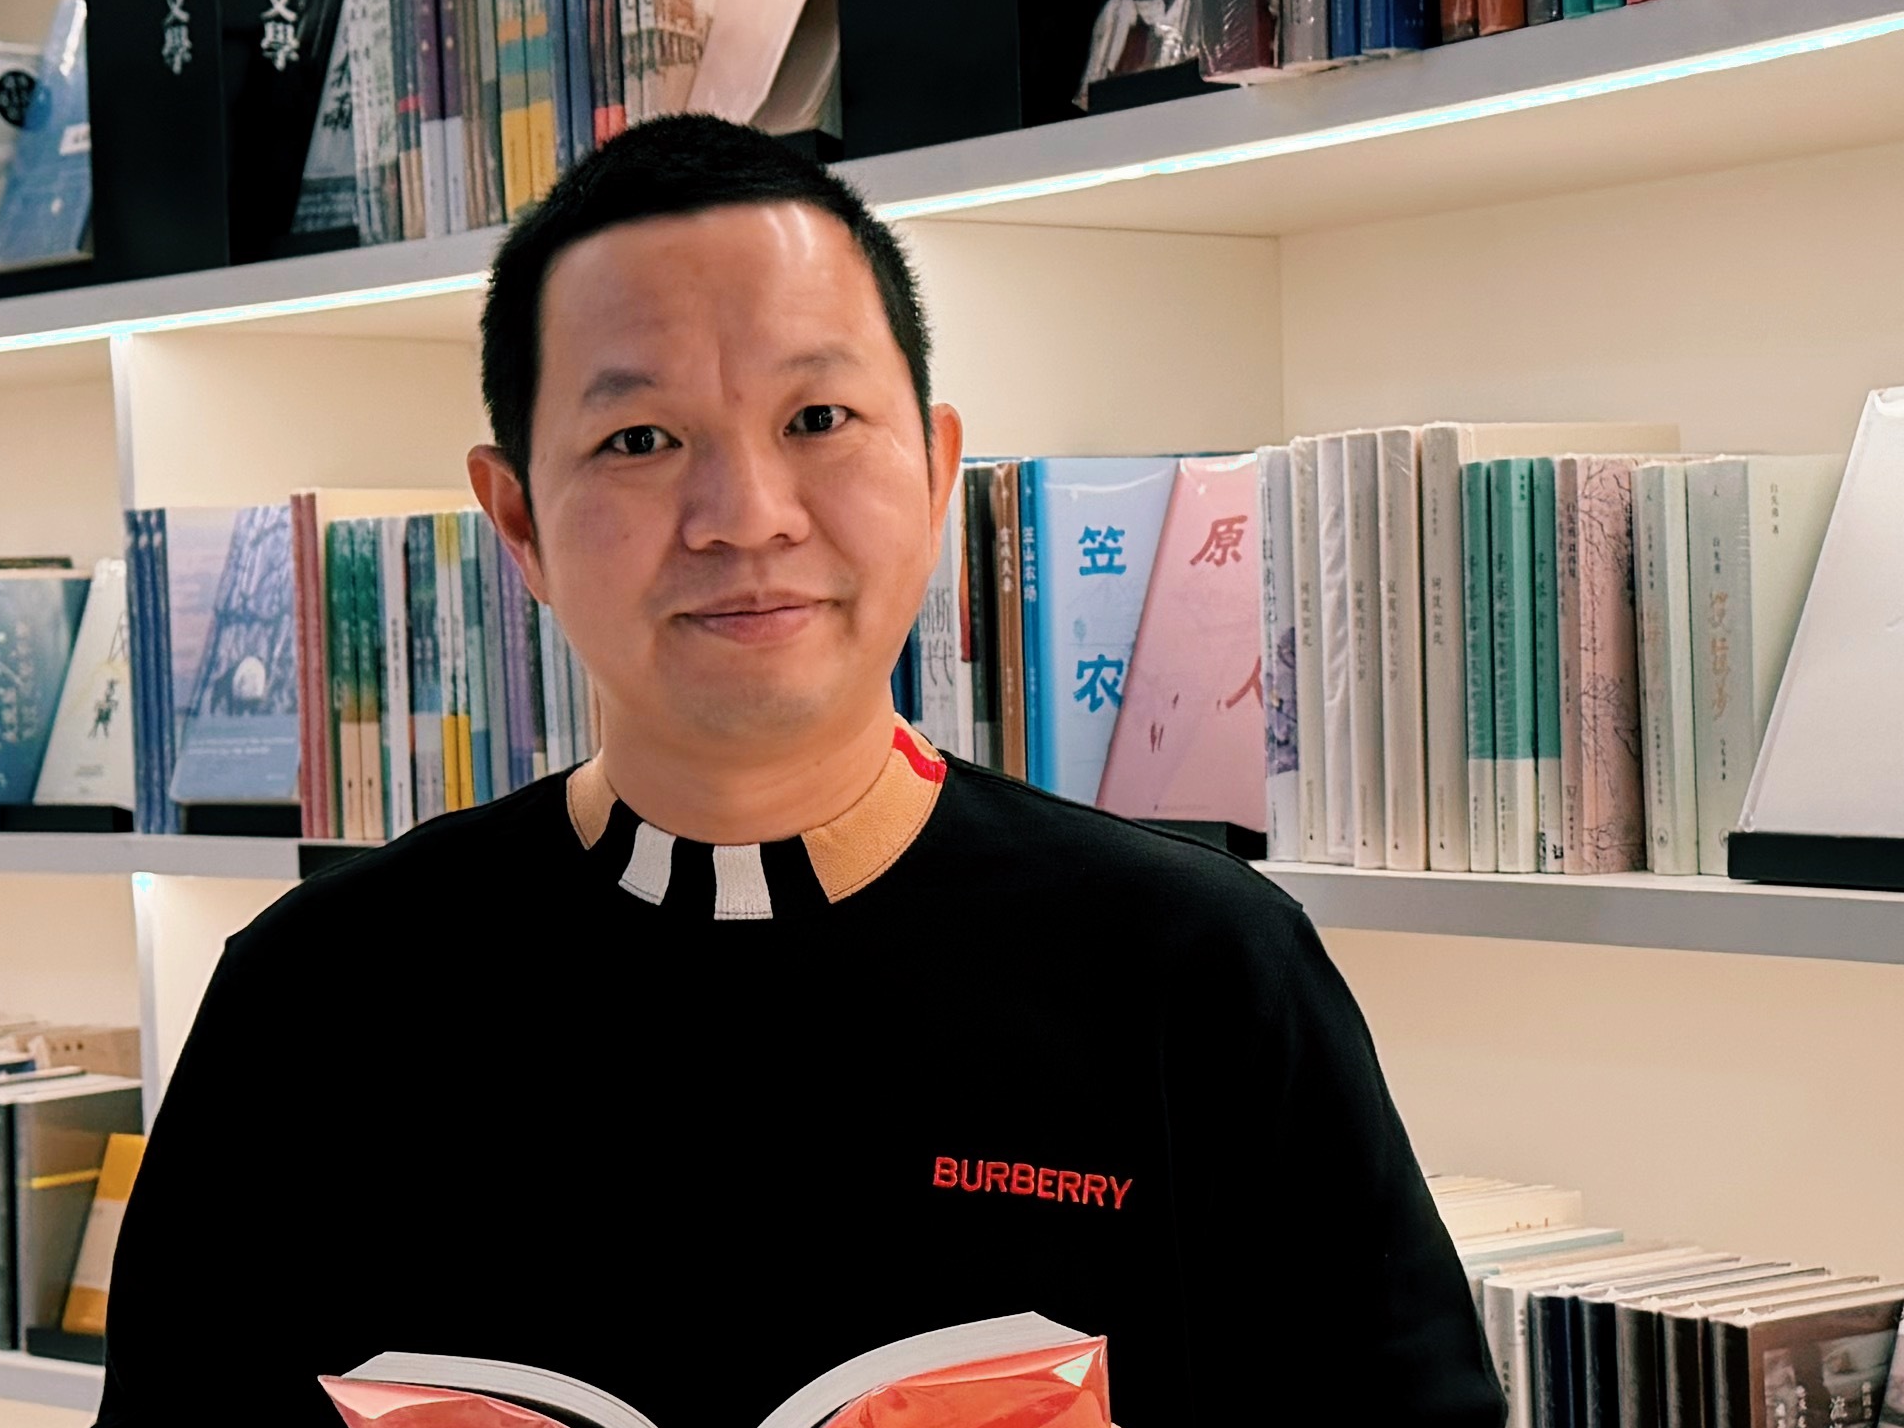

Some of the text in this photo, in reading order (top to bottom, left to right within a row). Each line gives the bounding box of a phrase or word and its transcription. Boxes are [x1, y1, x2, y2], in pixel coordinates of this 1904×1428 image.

[1021, 525, 1039, 604] 笠山农场
[1077, 524, 1128, 577] 笠
[1189, 514, 1249, 569] 原
[1072, 653, 1126, 714] 农
[933, 1156, 1134, 1210] BURBERRY
